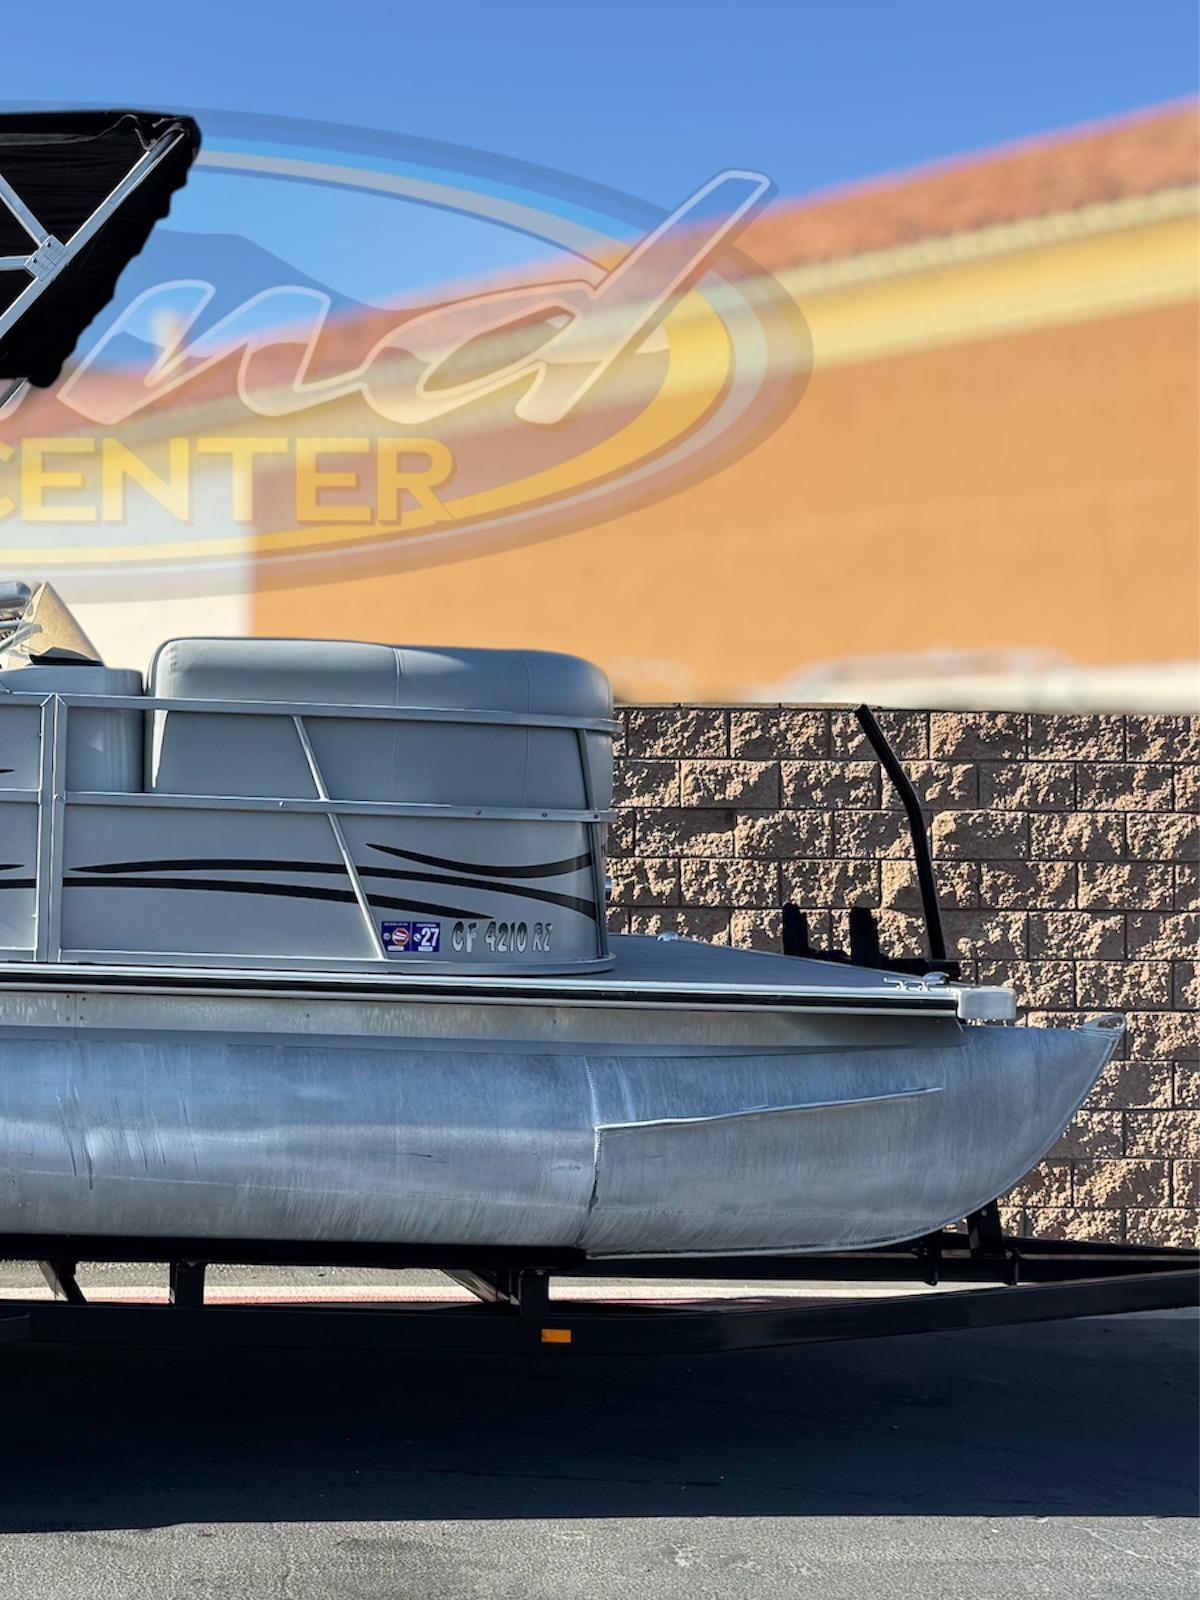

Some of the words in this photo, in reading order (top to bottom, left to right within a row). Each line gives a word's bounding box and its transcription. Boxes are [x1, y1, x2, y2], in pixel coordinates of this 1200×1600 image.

[420, 927, 440, 947] 27
[452, 920, 479, 952] CF
[484, 920, 528, 953] 4210
